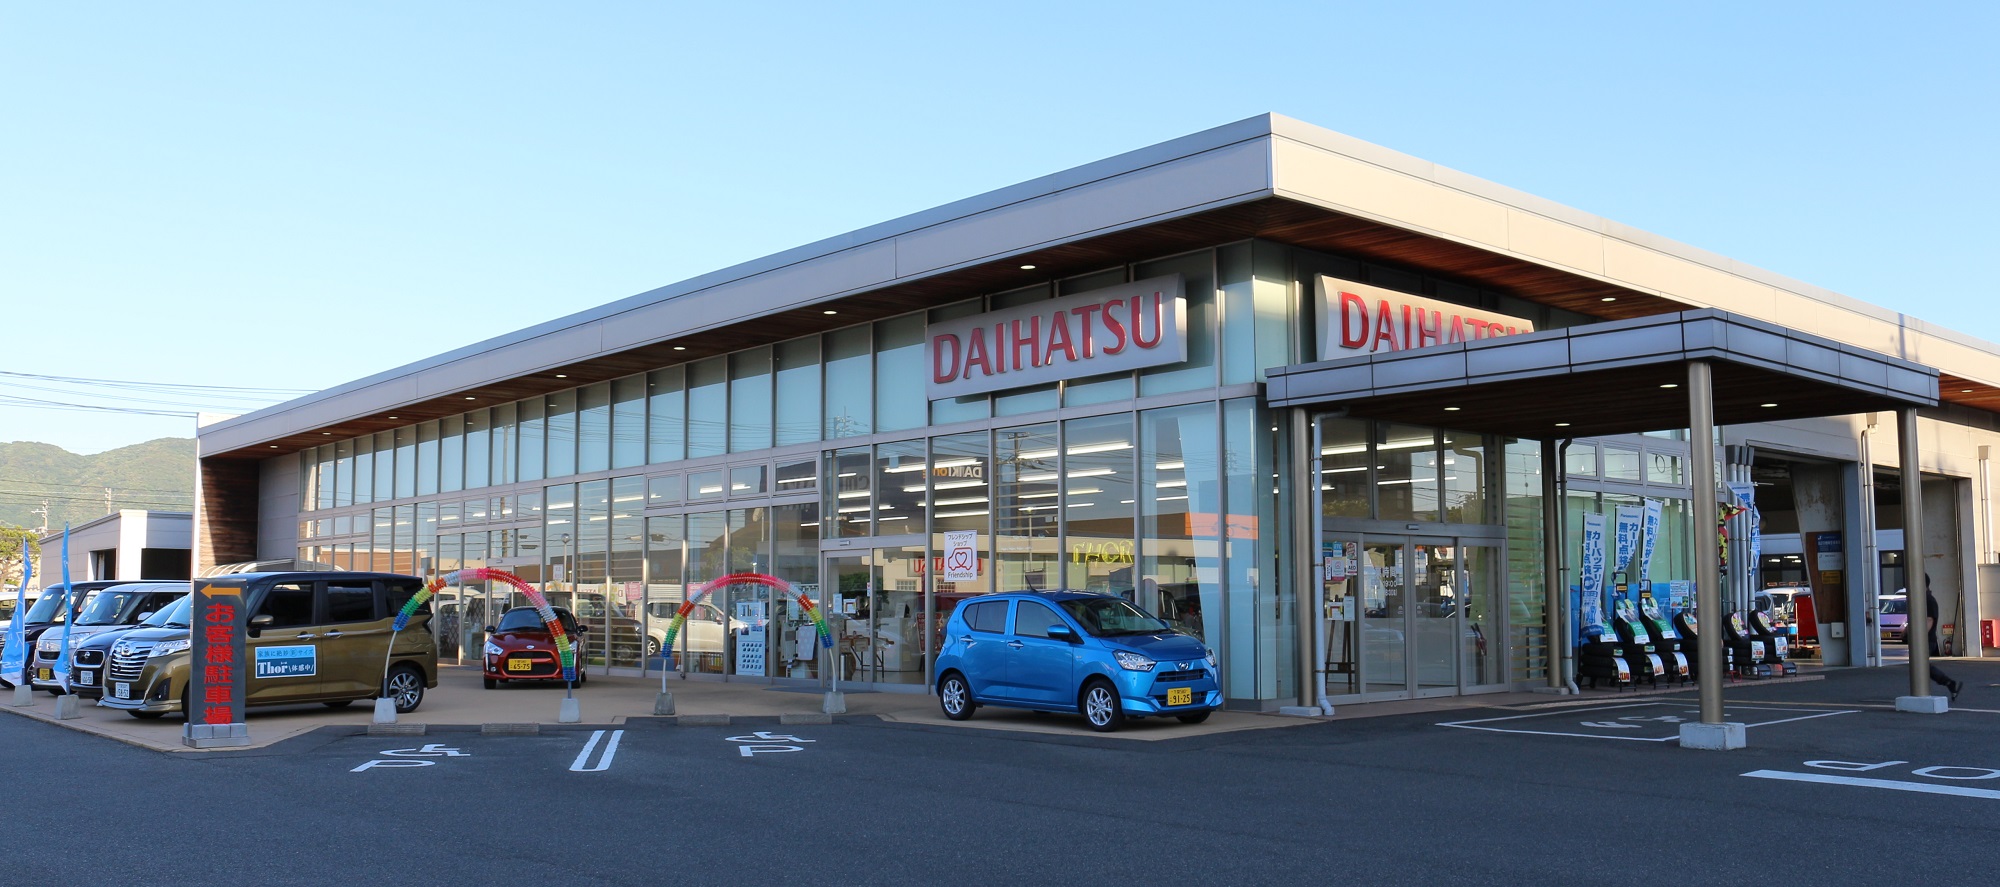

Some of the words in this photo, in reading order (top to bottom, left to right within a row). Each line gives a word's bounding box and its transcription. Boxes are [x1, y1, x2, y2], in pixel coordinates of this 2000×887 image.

[933, 291, 1163, 384] DAIHATSU
[1618, 522, 1629, 566] 無料点検
[203, 602, 235, 725] お客様駐車場
[258, 661, 287, 674] Thor
